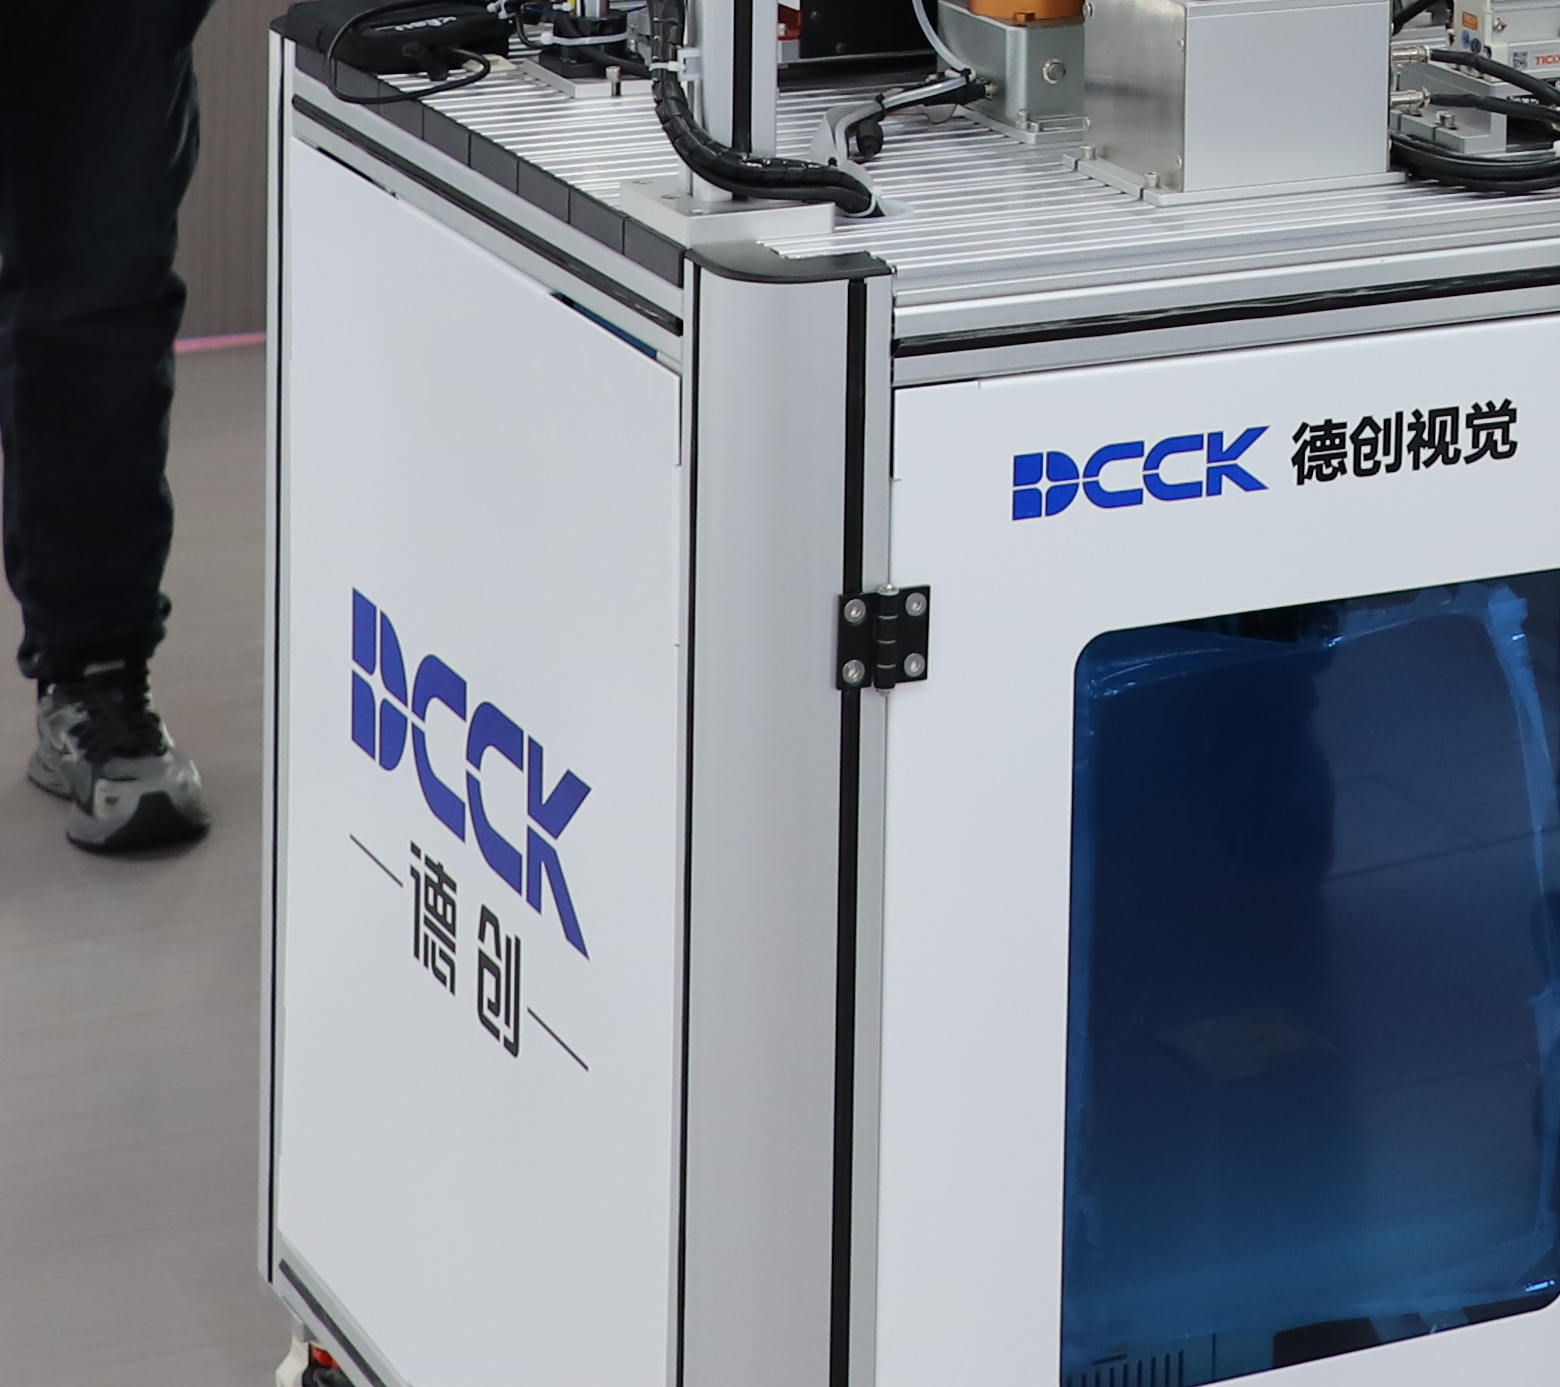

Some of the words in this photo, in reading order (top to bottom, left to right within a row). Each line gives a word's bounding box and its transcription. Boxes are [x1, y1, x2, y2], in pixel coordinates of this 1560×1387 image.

[1011, 425, 1272, 521] DCCK
[1290, 397, 1519, 486] 德创视觉
[352, 587, 592, 960] DCCK
[410, 840, 522, 1058] 德创
